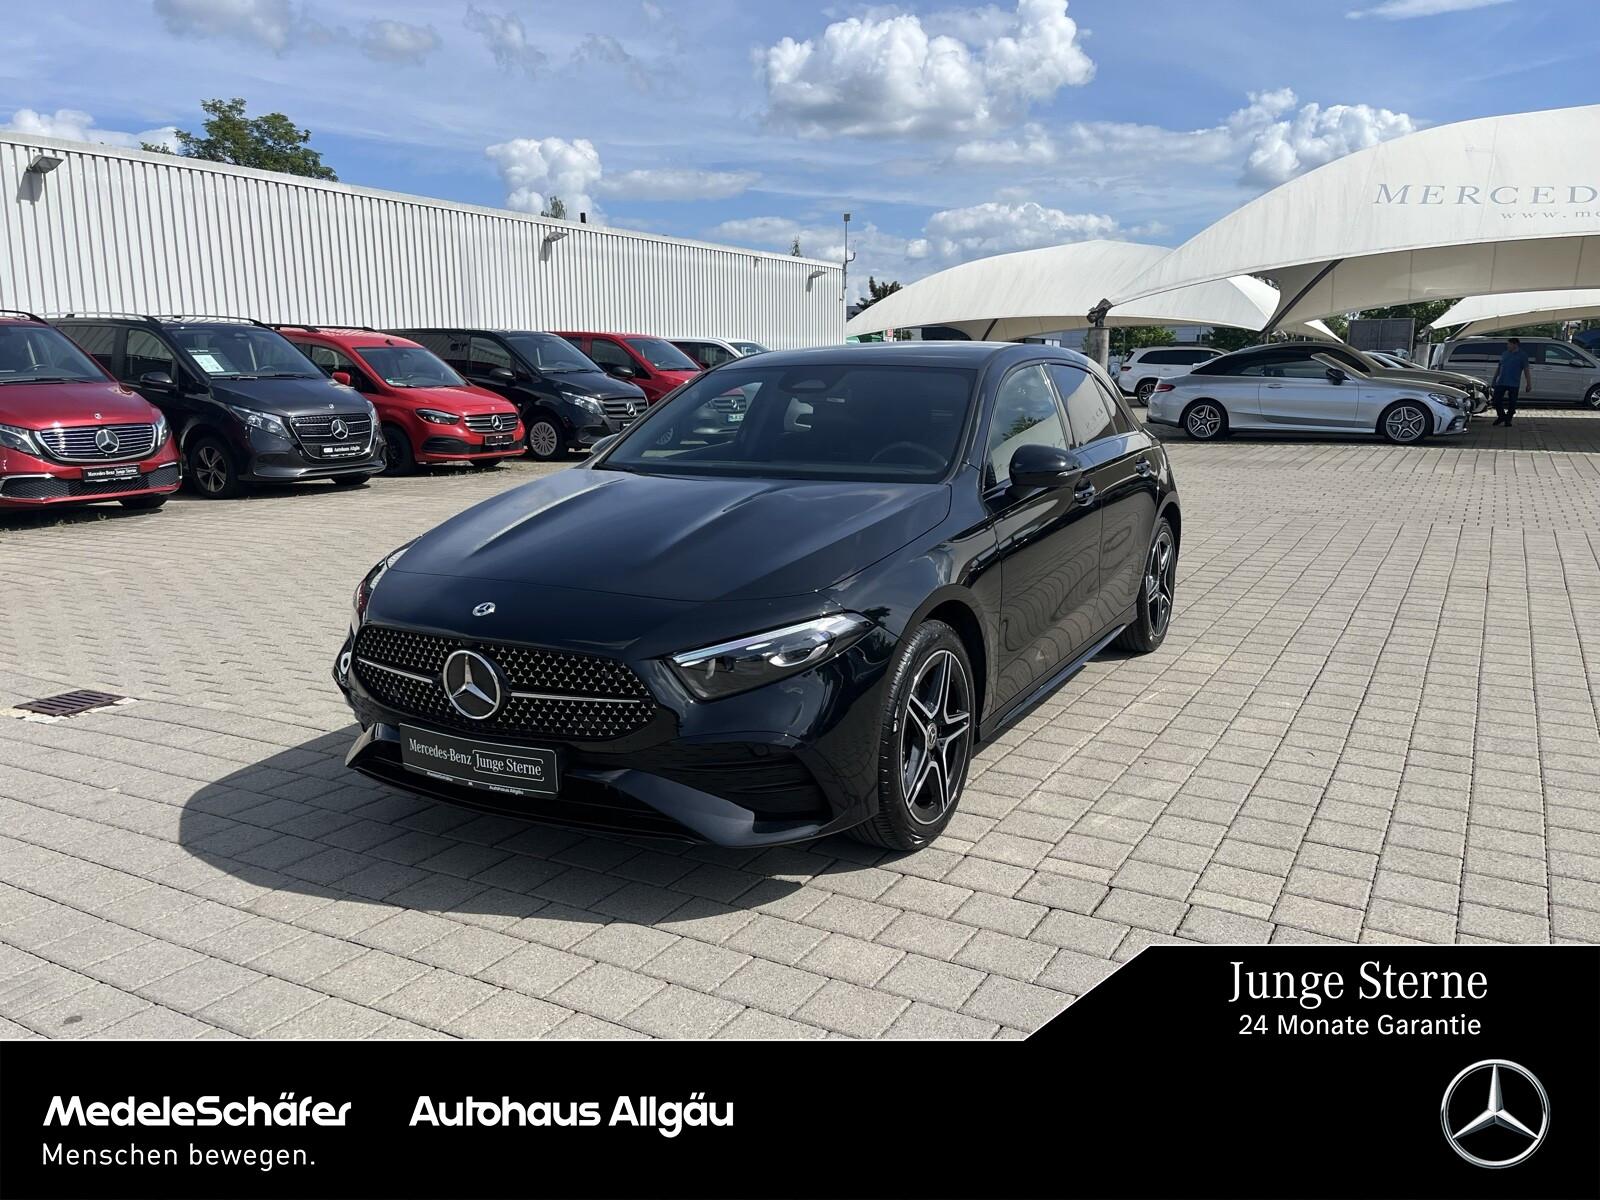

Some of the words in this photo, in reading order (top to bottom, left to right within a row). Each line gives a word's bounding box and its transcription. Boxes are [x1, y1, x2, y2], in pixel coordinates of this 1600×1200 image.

[1373, 183, 1598, 205] MERCED
[408, 737, 472, 766] Mercedes-Benz
[475, 753, 504, 772] Junge
[506, 758, 542, 776] Sterne
